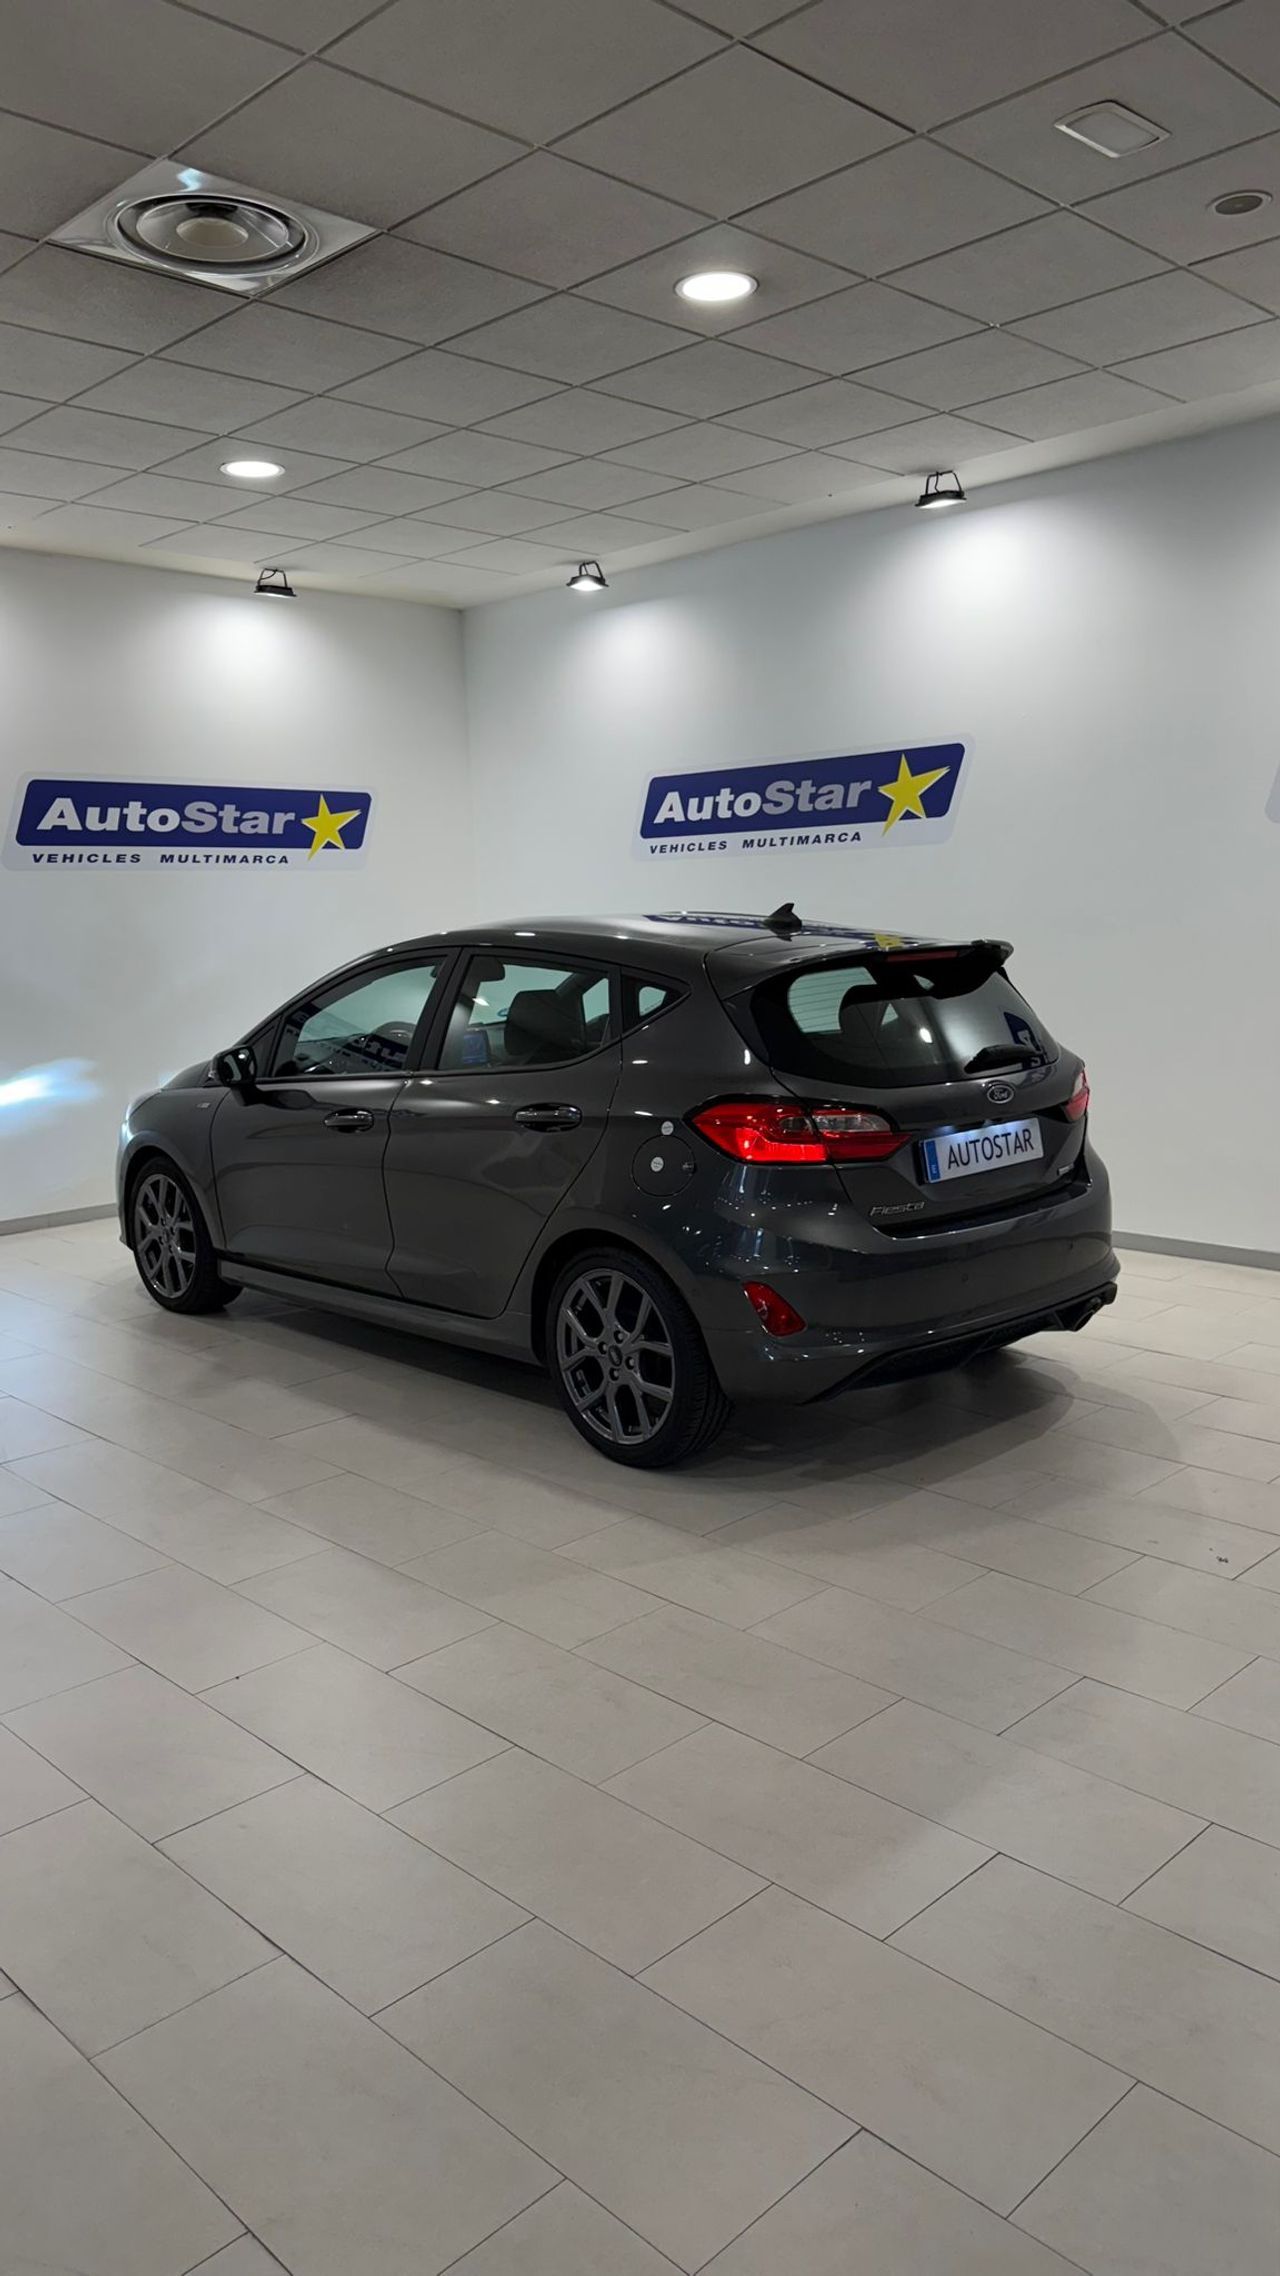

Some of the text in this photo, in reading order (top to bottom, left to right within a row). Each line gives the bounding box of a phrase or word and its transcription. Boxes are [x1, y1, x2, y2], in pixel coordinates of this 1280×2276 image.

[36, 797, 296, 835] AutoStar
[653, 780, 872, 824] AutoStar
[650, 832, 861, 854] VEHICLES MULTIMARCA
[32, 853, 289, 864] VEHICLES MULTIMARCA
[947, 1128, 1034, 1170] AUTOSTAR
[869, 1201, 925, 1216] Fiesta
